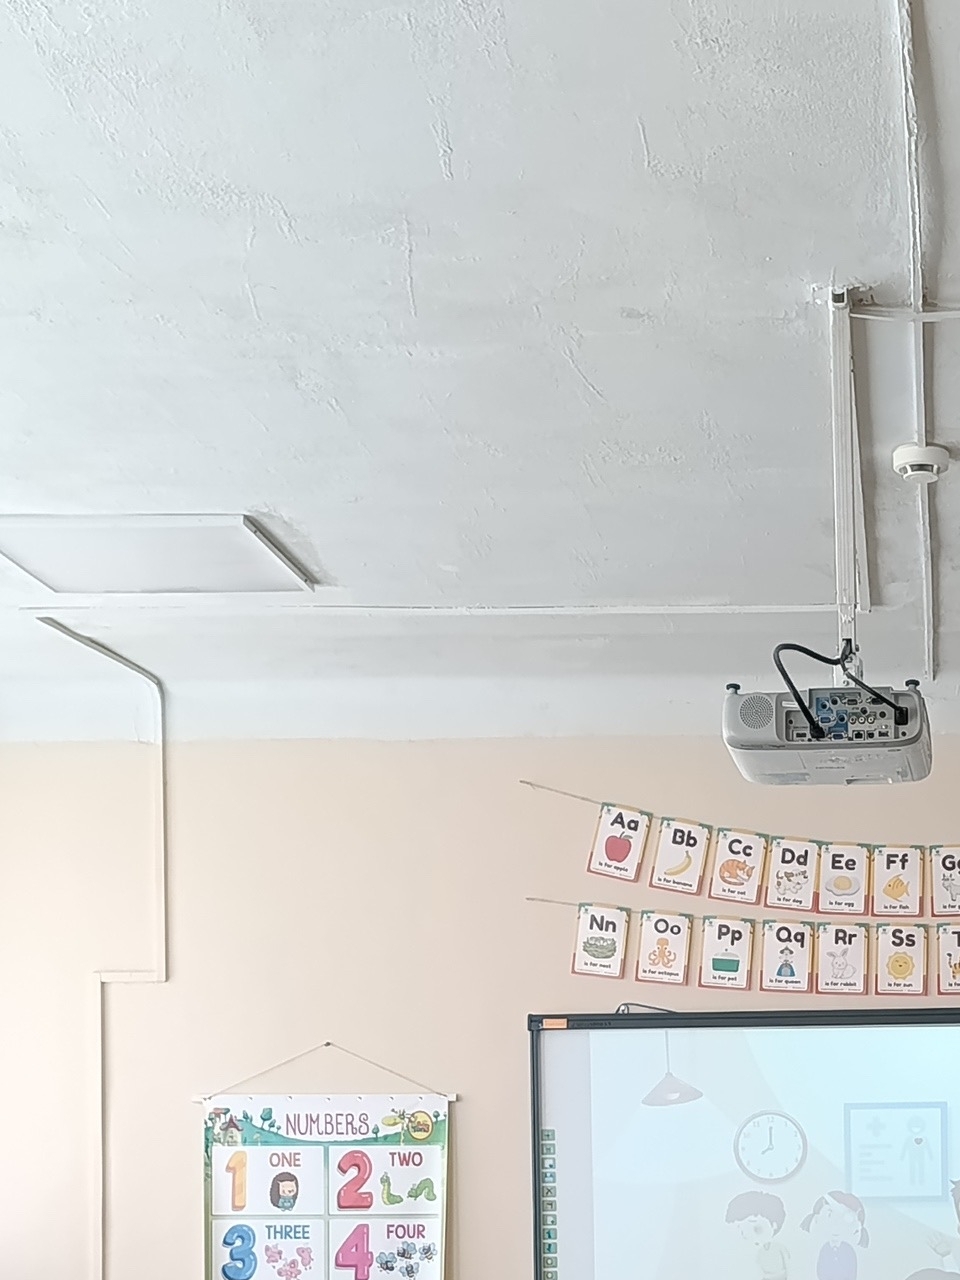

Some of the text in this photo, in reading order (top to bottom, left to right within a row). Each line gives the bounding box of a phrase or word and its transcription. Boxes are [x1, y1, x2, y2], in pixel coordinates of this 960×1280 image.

[610, 812, 639, 832] Aa
[672, 829, 698, 847] Bb
[728, 839, 753, 856] Cc
[781, 848, 808, 866] Dd
[831, 854, 856, 870] Ee
[886, 854, 908, 870] Ff
[589, 914, 616, 932] Nn
[654, 918, 681, 936] Oo
[718, 924, 742, 946] Pp
[776, 926, 805, 948] Qq
[834, 928, 858, 945] Rr
[892, 928, 916, 947] Ss
[286, 1112, 369, 1137] NUMBERS
[269, 1152, 302, 1168] ONE
[388, 1152, 423, 1167] TWO
[225, 1150, 248, 1211] 1
[336, 1150, 374, 1210] 2
[265, 1224, 310, 1240] THREE
[386, 1224, 425, 1240] FOUR
